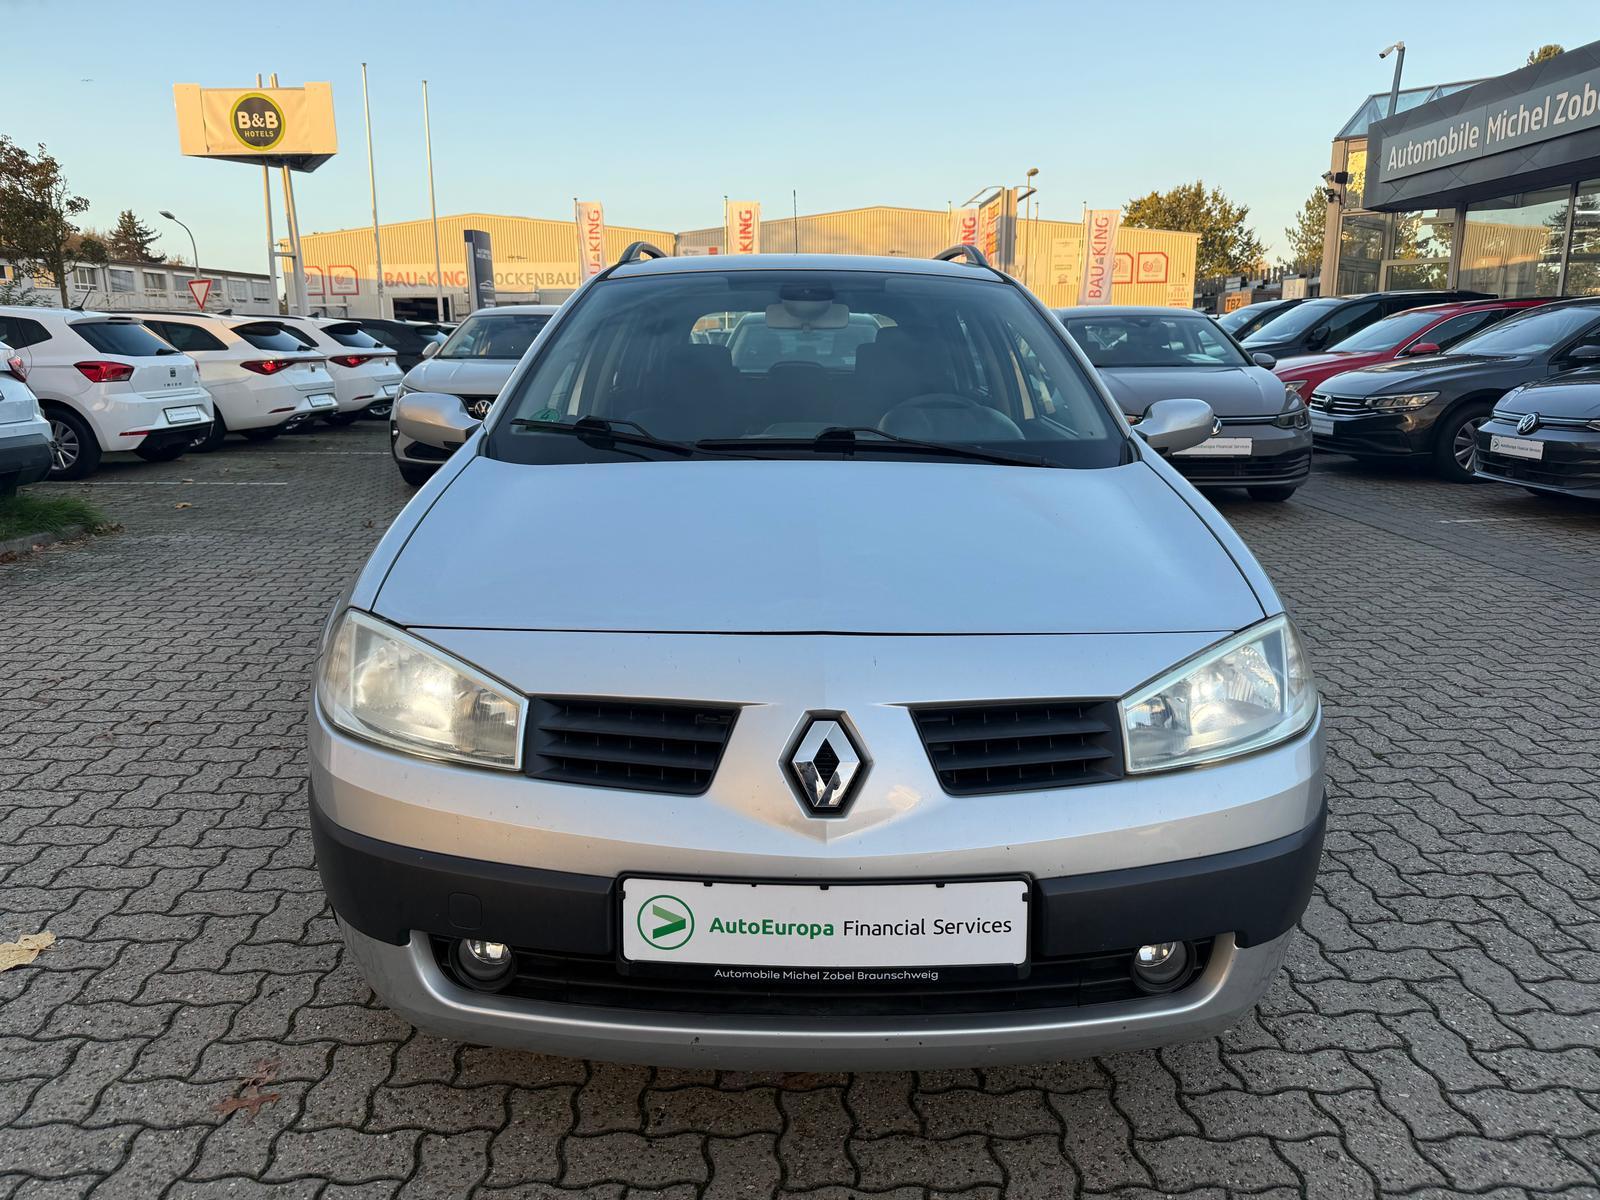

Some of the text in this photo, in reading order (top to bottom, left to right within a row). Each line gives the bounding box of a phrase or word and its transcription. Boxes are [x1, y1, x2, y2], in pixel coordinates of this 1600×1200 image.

[237, 111, 278, 128] B&B
[1387, 82, 1600, 171] Automobile Michel Zob
[588, 210, 600, 251] KING
[739, 210, 753, 252] KING
[962, 217, 976, 246] ING
[709, 917, 1012, 940] AutoEuropa Financial Services
[714, 969, 939, 981] Automobile Michel Zobel Braunschweig
